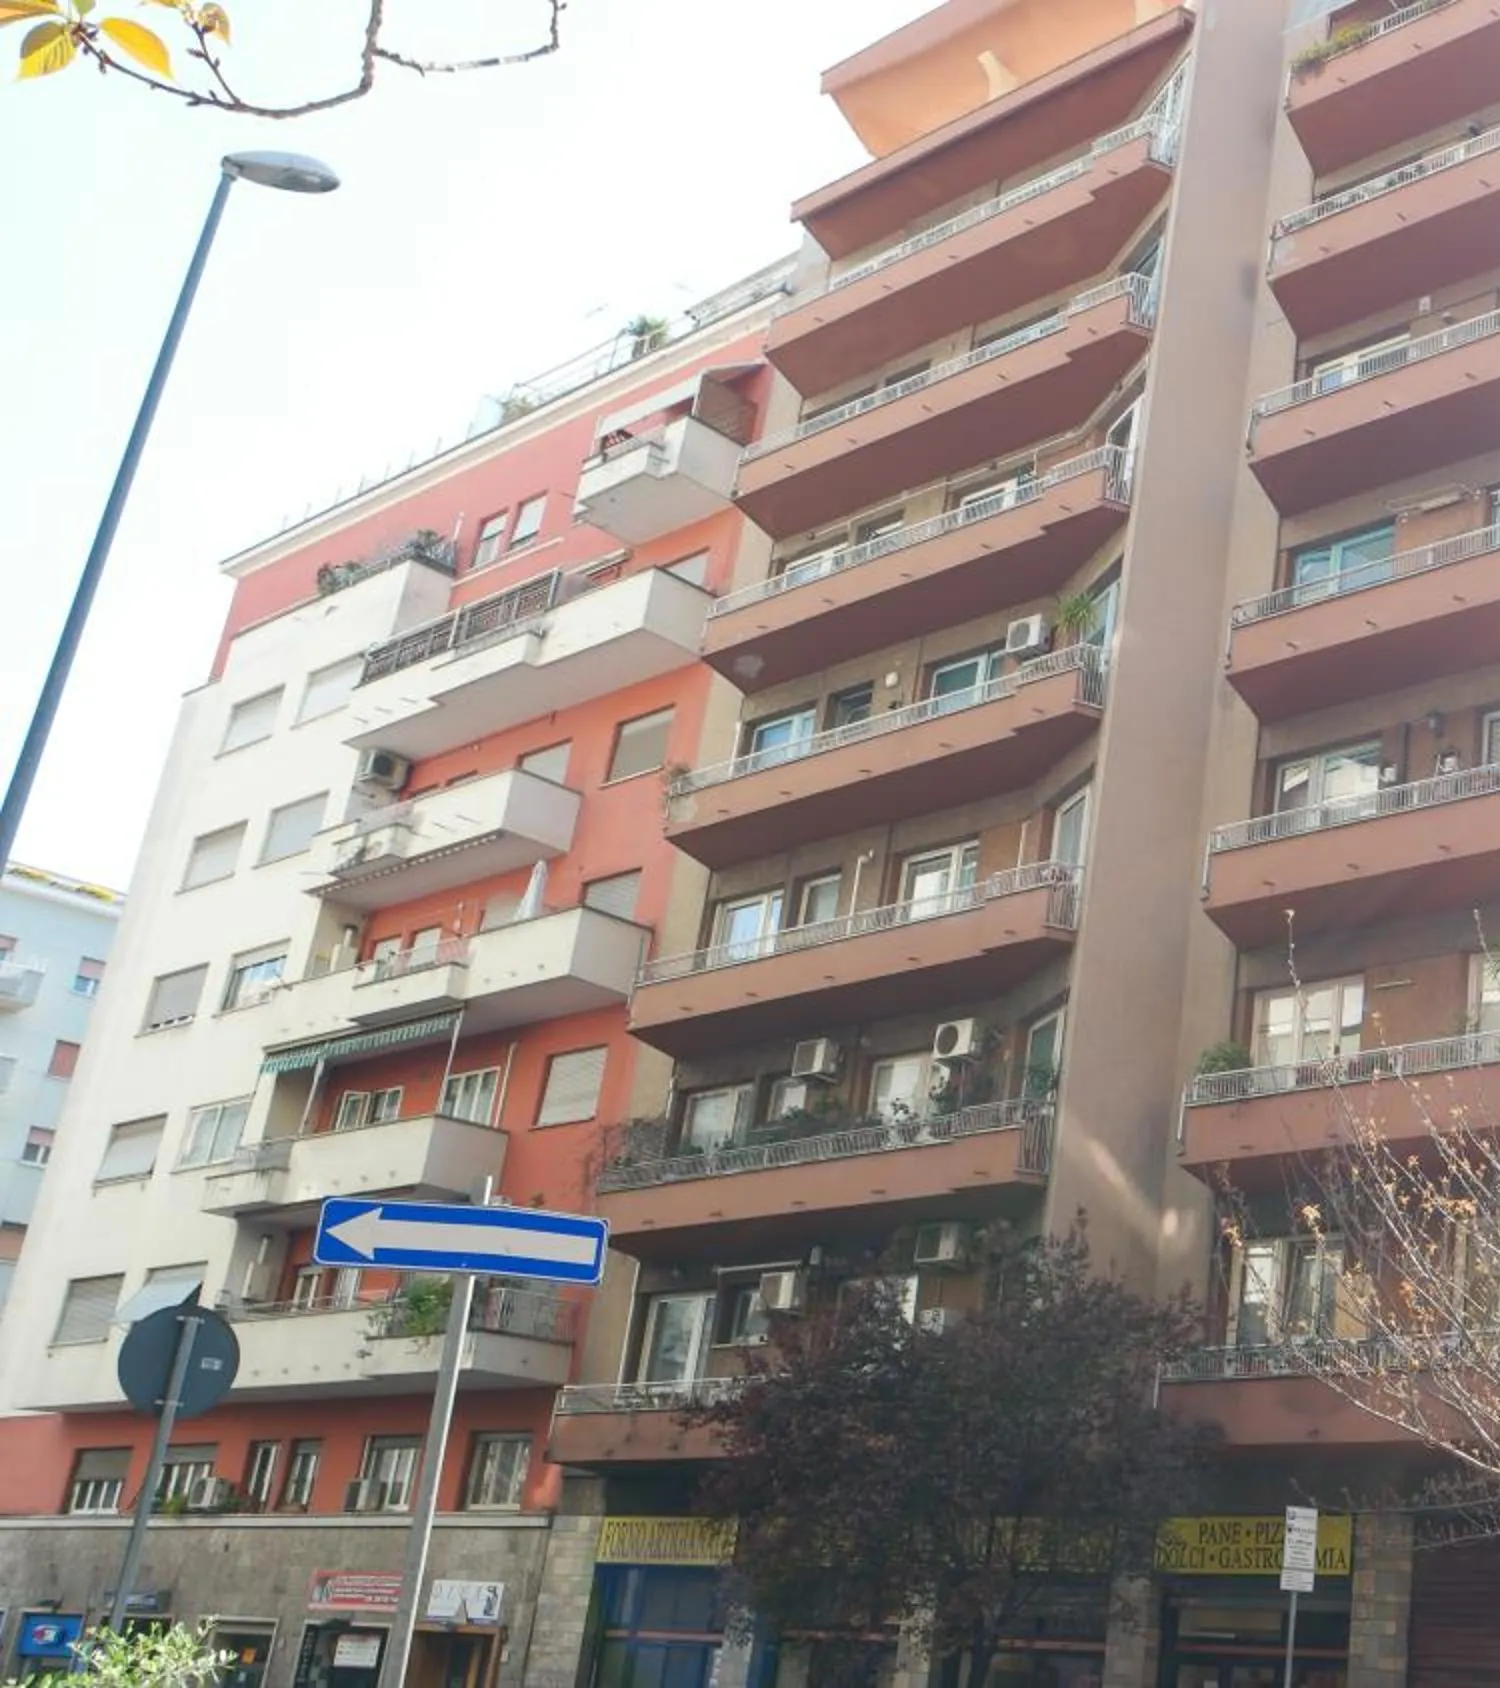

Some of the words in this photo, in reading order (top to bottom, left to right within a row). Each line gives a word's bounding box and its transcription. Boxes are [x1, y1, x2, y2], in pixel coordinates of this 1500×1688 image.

[1198, 1521, 1242, 1545] PANE
[1255, 1522, 1285, 1547] PIZ
[1218, 1547, 1347, 1570] GASTROMIA
